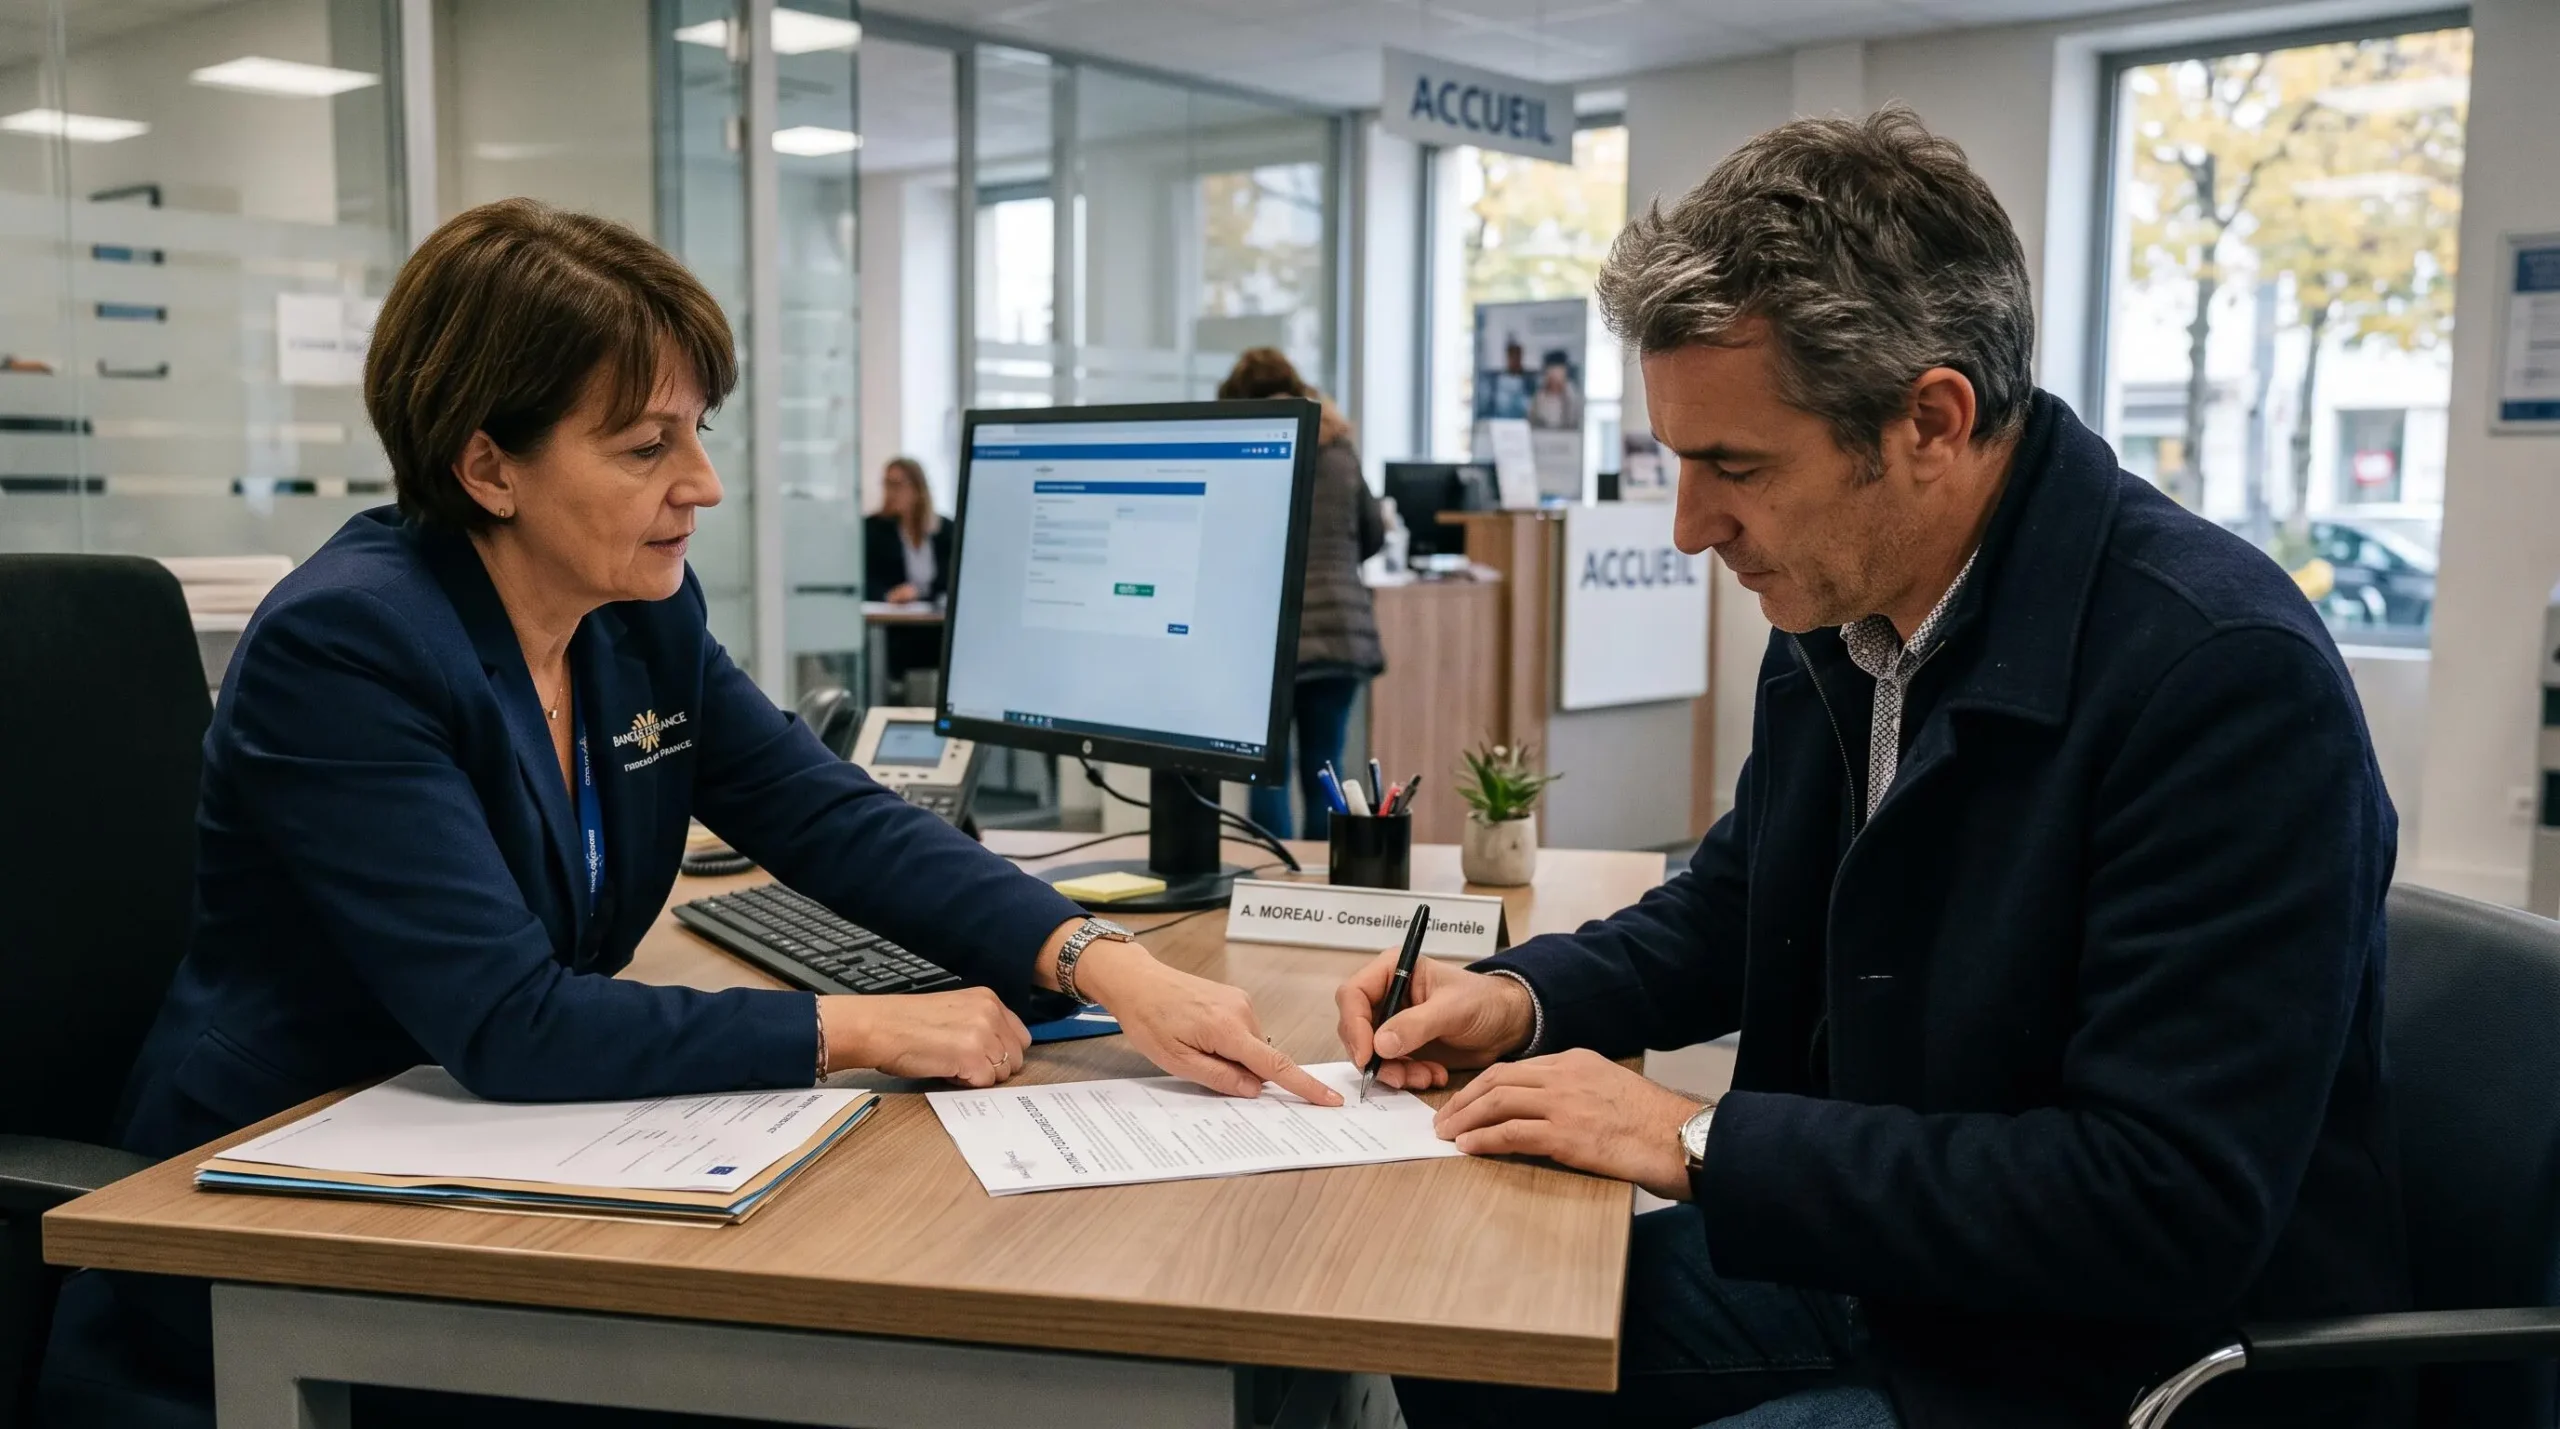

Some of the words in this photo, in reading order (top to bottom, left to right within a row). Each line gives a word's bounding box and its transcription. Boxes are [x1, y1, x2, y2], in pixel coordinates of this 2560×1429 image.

[1410, 74, 1555, 145] ACCUEIL
[1240, 904, 1255, 917] A.
[1260, 905, 1325, 922] MOREAU
[1337, 911, 1410, 929] Conseillèr
